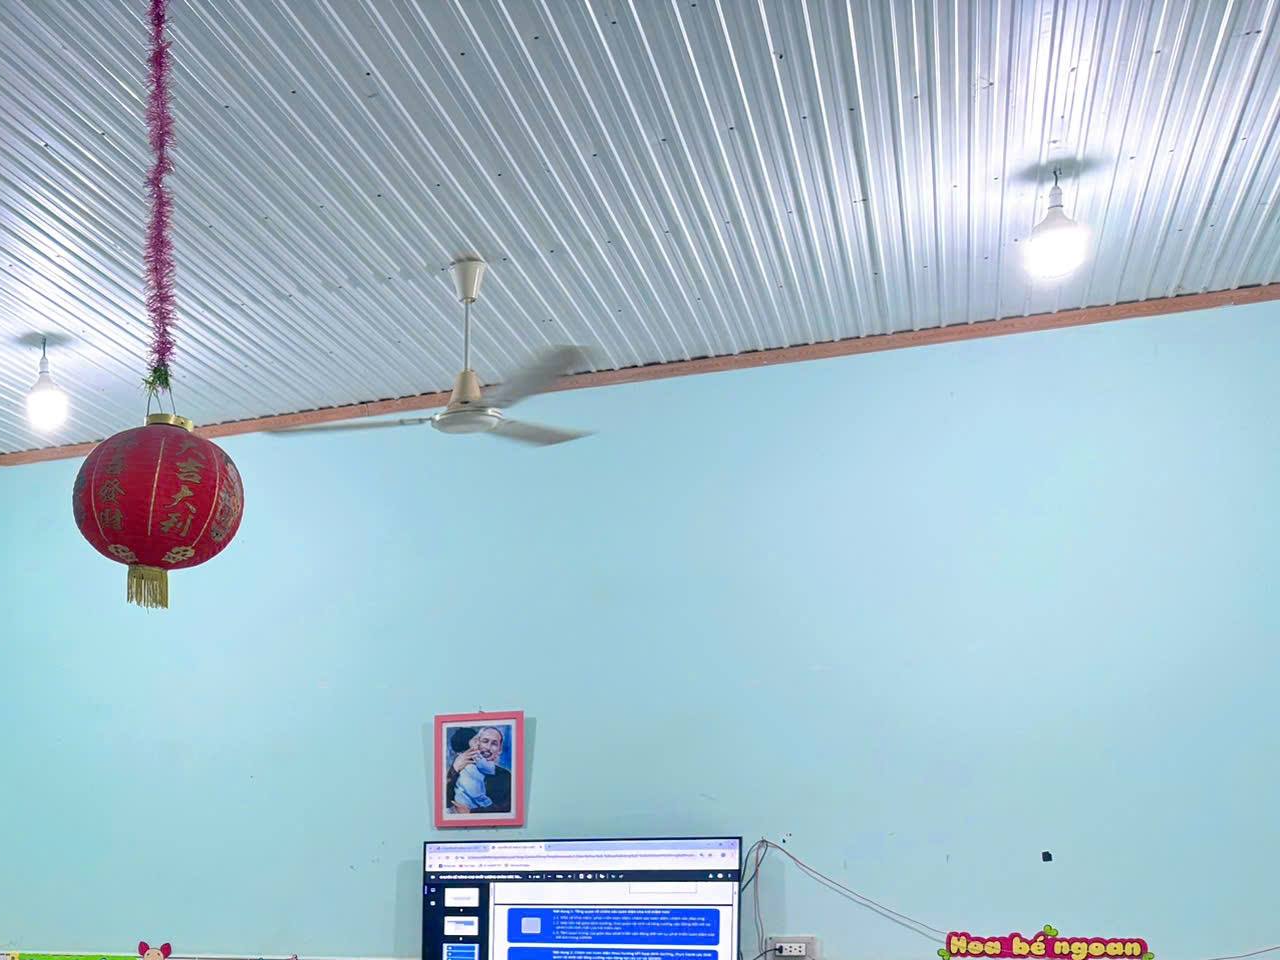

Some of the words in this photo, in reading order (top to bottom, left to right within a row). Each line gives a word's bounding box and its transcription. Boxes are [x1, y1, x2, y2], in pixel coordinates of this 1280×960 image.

[160, 440, 206, 537] 大吉大利
[950, 936, 1001, 955] Hoa
[1012, 936, 1046, 956] bé
